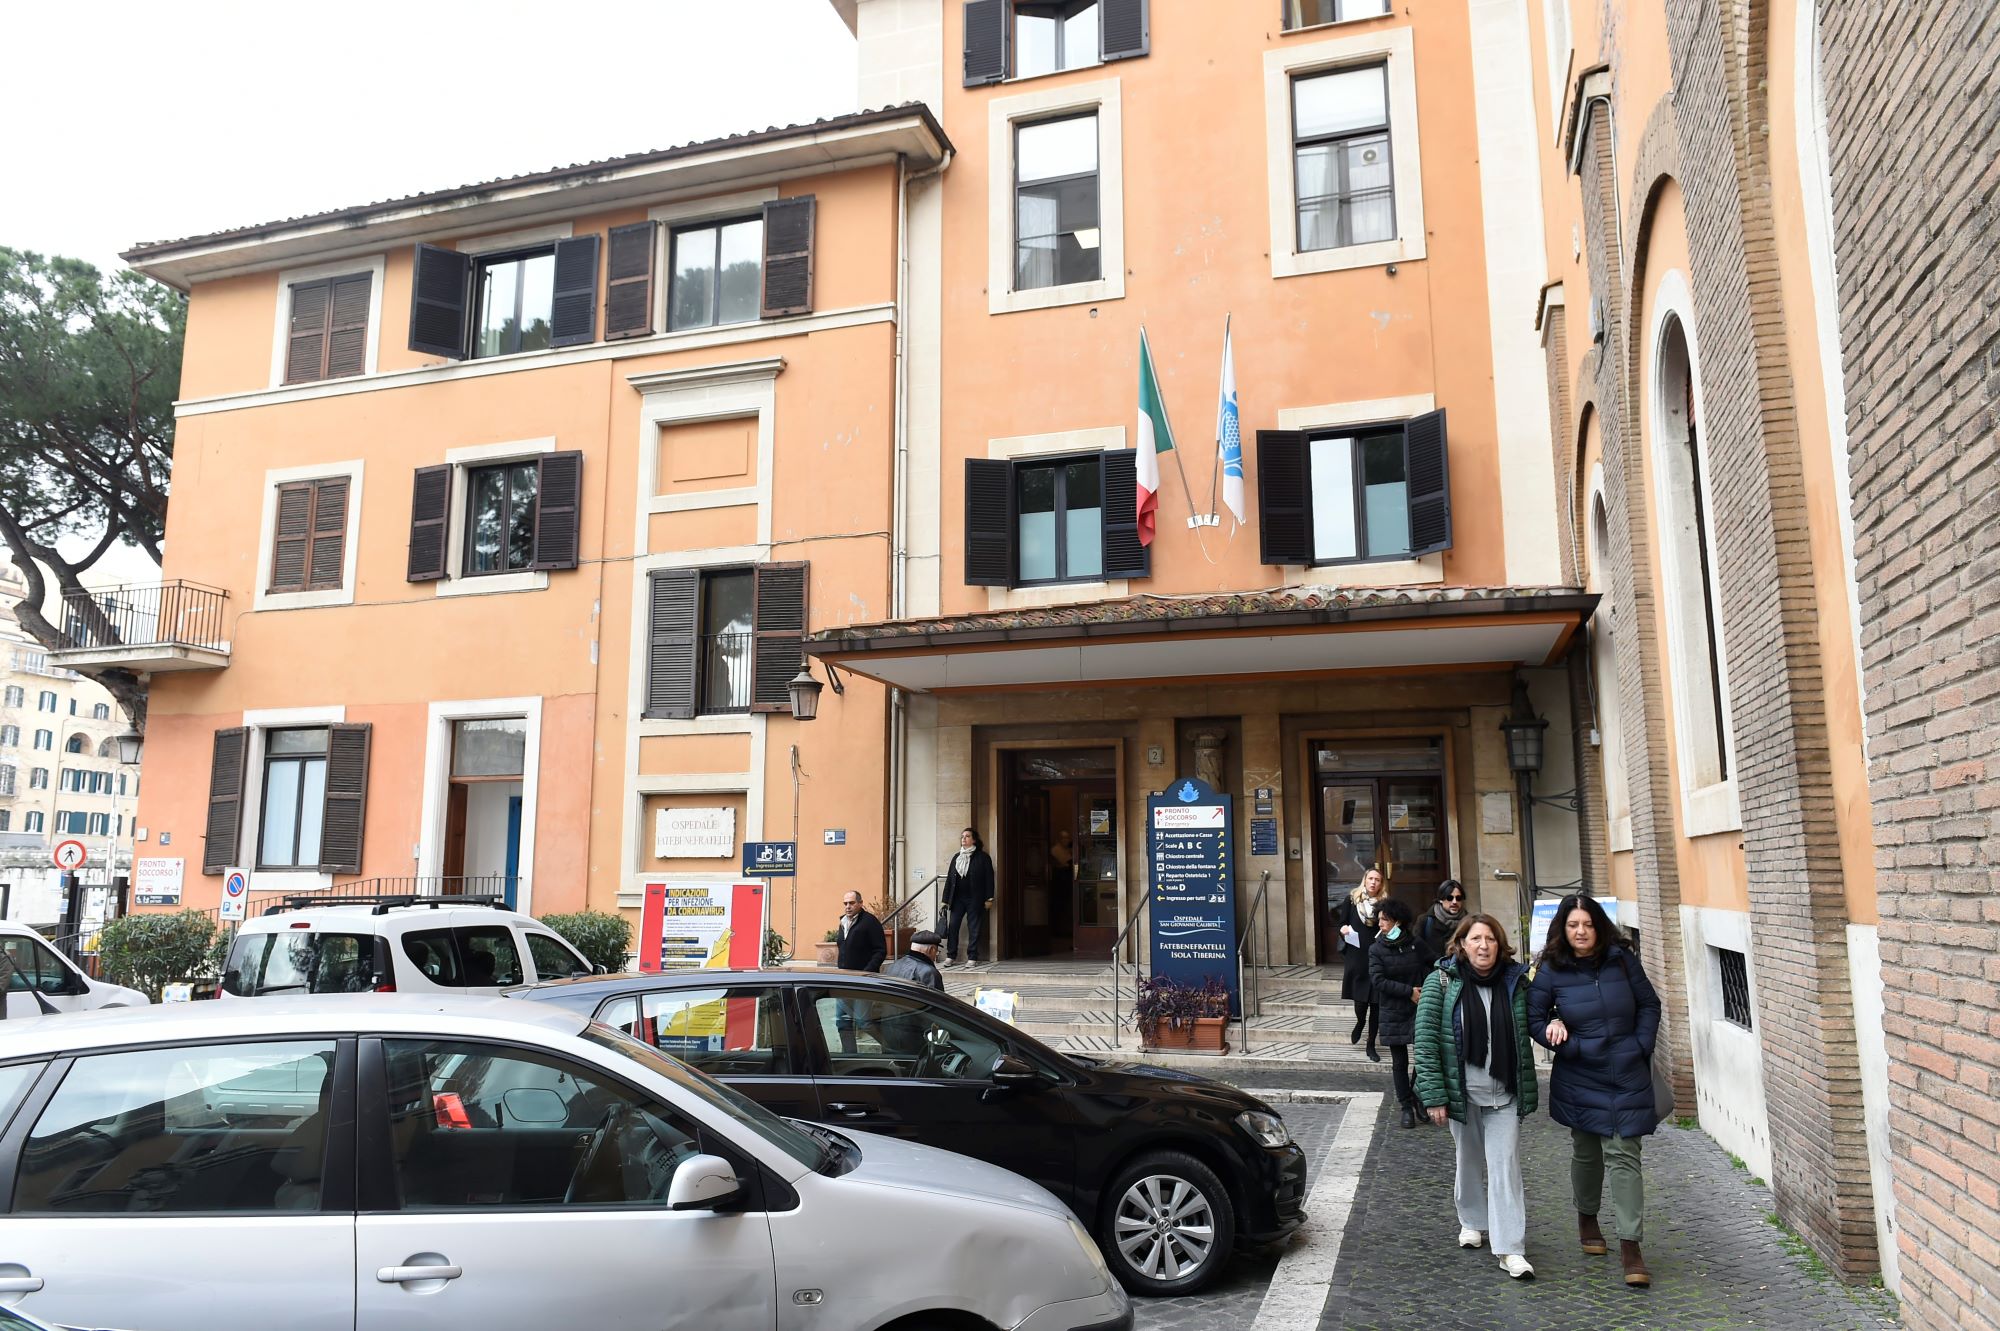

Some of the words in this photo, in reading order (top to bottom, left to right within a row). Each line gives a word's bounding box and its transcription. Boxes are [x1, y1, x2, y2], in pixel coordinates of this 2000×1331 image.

[1152, 751, 1158, 760] 2
[671, 820, 718, 830] OSPEDALE
[657, 835, 731, 846] FATEBENEFRATELLI
[139, 860, 167, 868] PRONTO
[138, 869, 174, 877] SOCCORSO
[668, 888, 708, 898] INDICAZIONI
[668, 898, 679, 906] PER
[680, 898, 714, 906] INFEZIONE
[667, 907, 677, 916] DA
[678, 906, 724, 916] CORONAVIRUS
